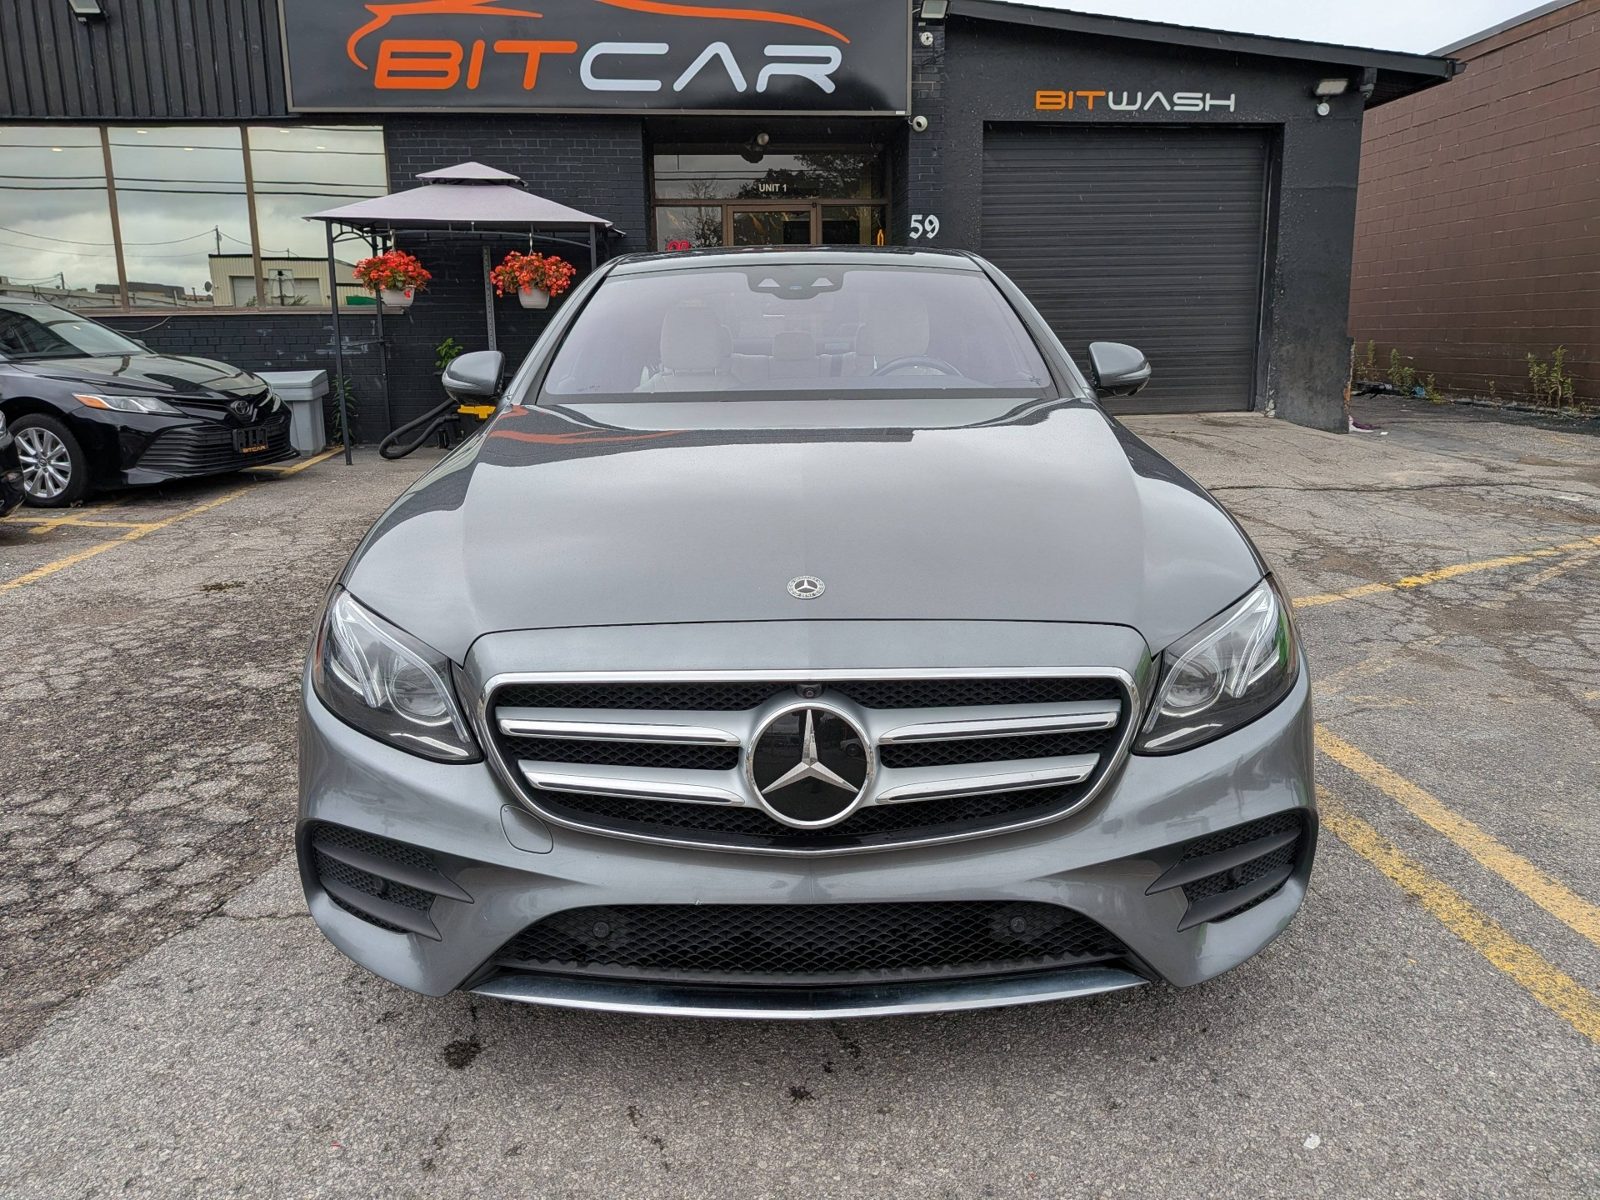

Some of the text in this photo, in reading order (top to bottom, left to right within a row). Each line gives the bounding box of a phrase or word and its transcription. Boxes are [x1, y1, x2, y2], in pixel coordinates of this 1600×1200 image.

[374, 39, 843, 94] BITCAR
[1035, 90, 1236, 112] BITWASH
[758, 183, 787, 193] UNIT 1
[909, 214, 940, 239] 59
